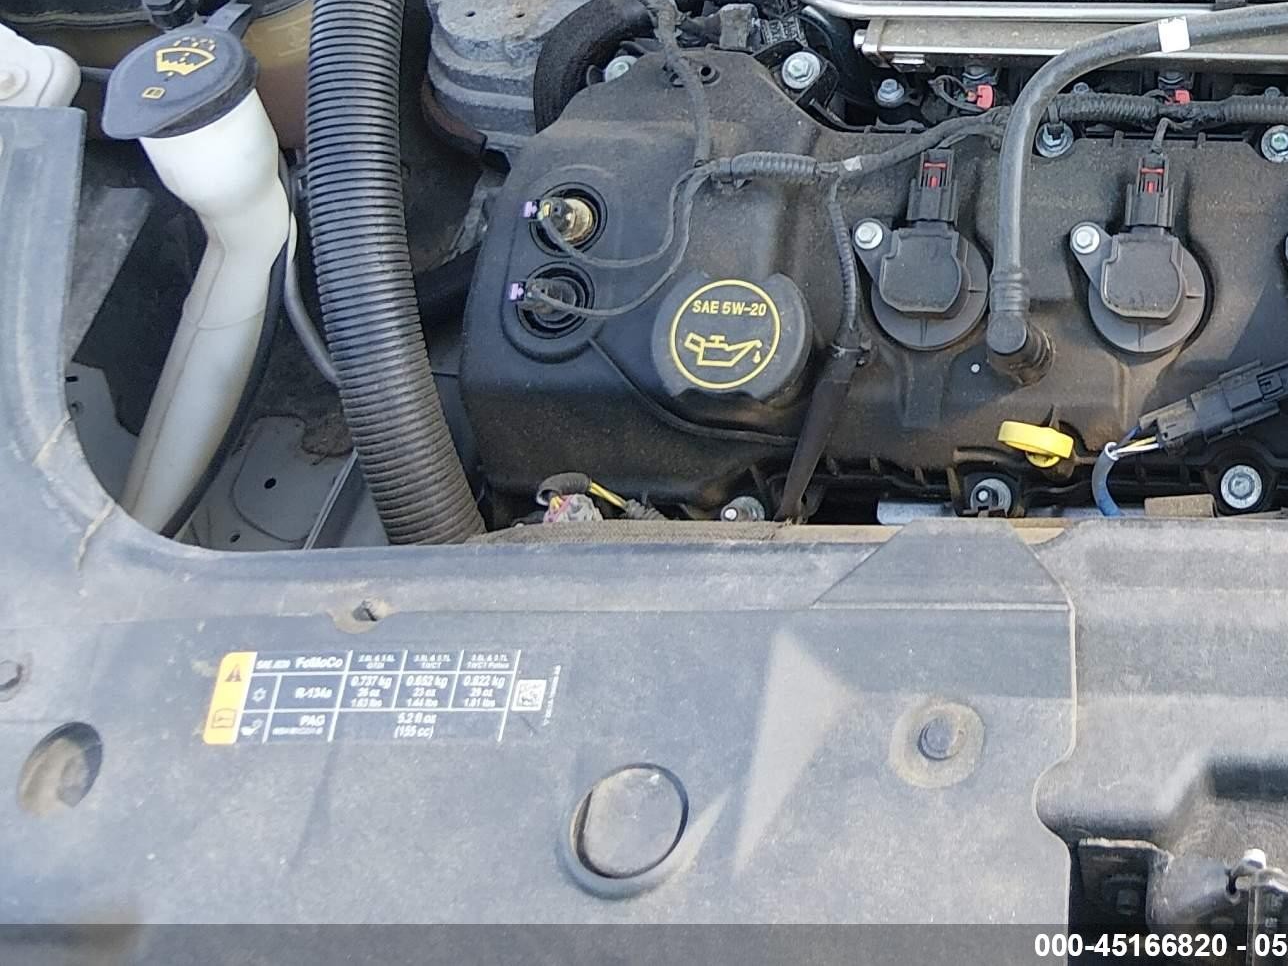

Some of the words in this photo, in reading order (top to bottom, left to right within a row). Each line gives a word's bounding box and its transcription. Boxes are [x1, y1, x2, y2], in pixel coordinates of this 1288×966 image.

[692, 300, 719, 314] SAE
[722, 301, 767, 317] 5W-20
[295, 656, 343, 669] FoMoCo
[351, 675, 378, 687] 0.737
[378, 675, 393, 689] kg
[434, 675, 449, 689] kg
[491, 675, 506, 689] kg
[295, 687, 333, 699] R-134a
[299, 714, 326, 727] PAG
[397, 712, 413, 724] 5.2
[423, 714, 437, 724] oz
[394, 725, 416, 738] (155
[417, 725, 434, 739] cc)
